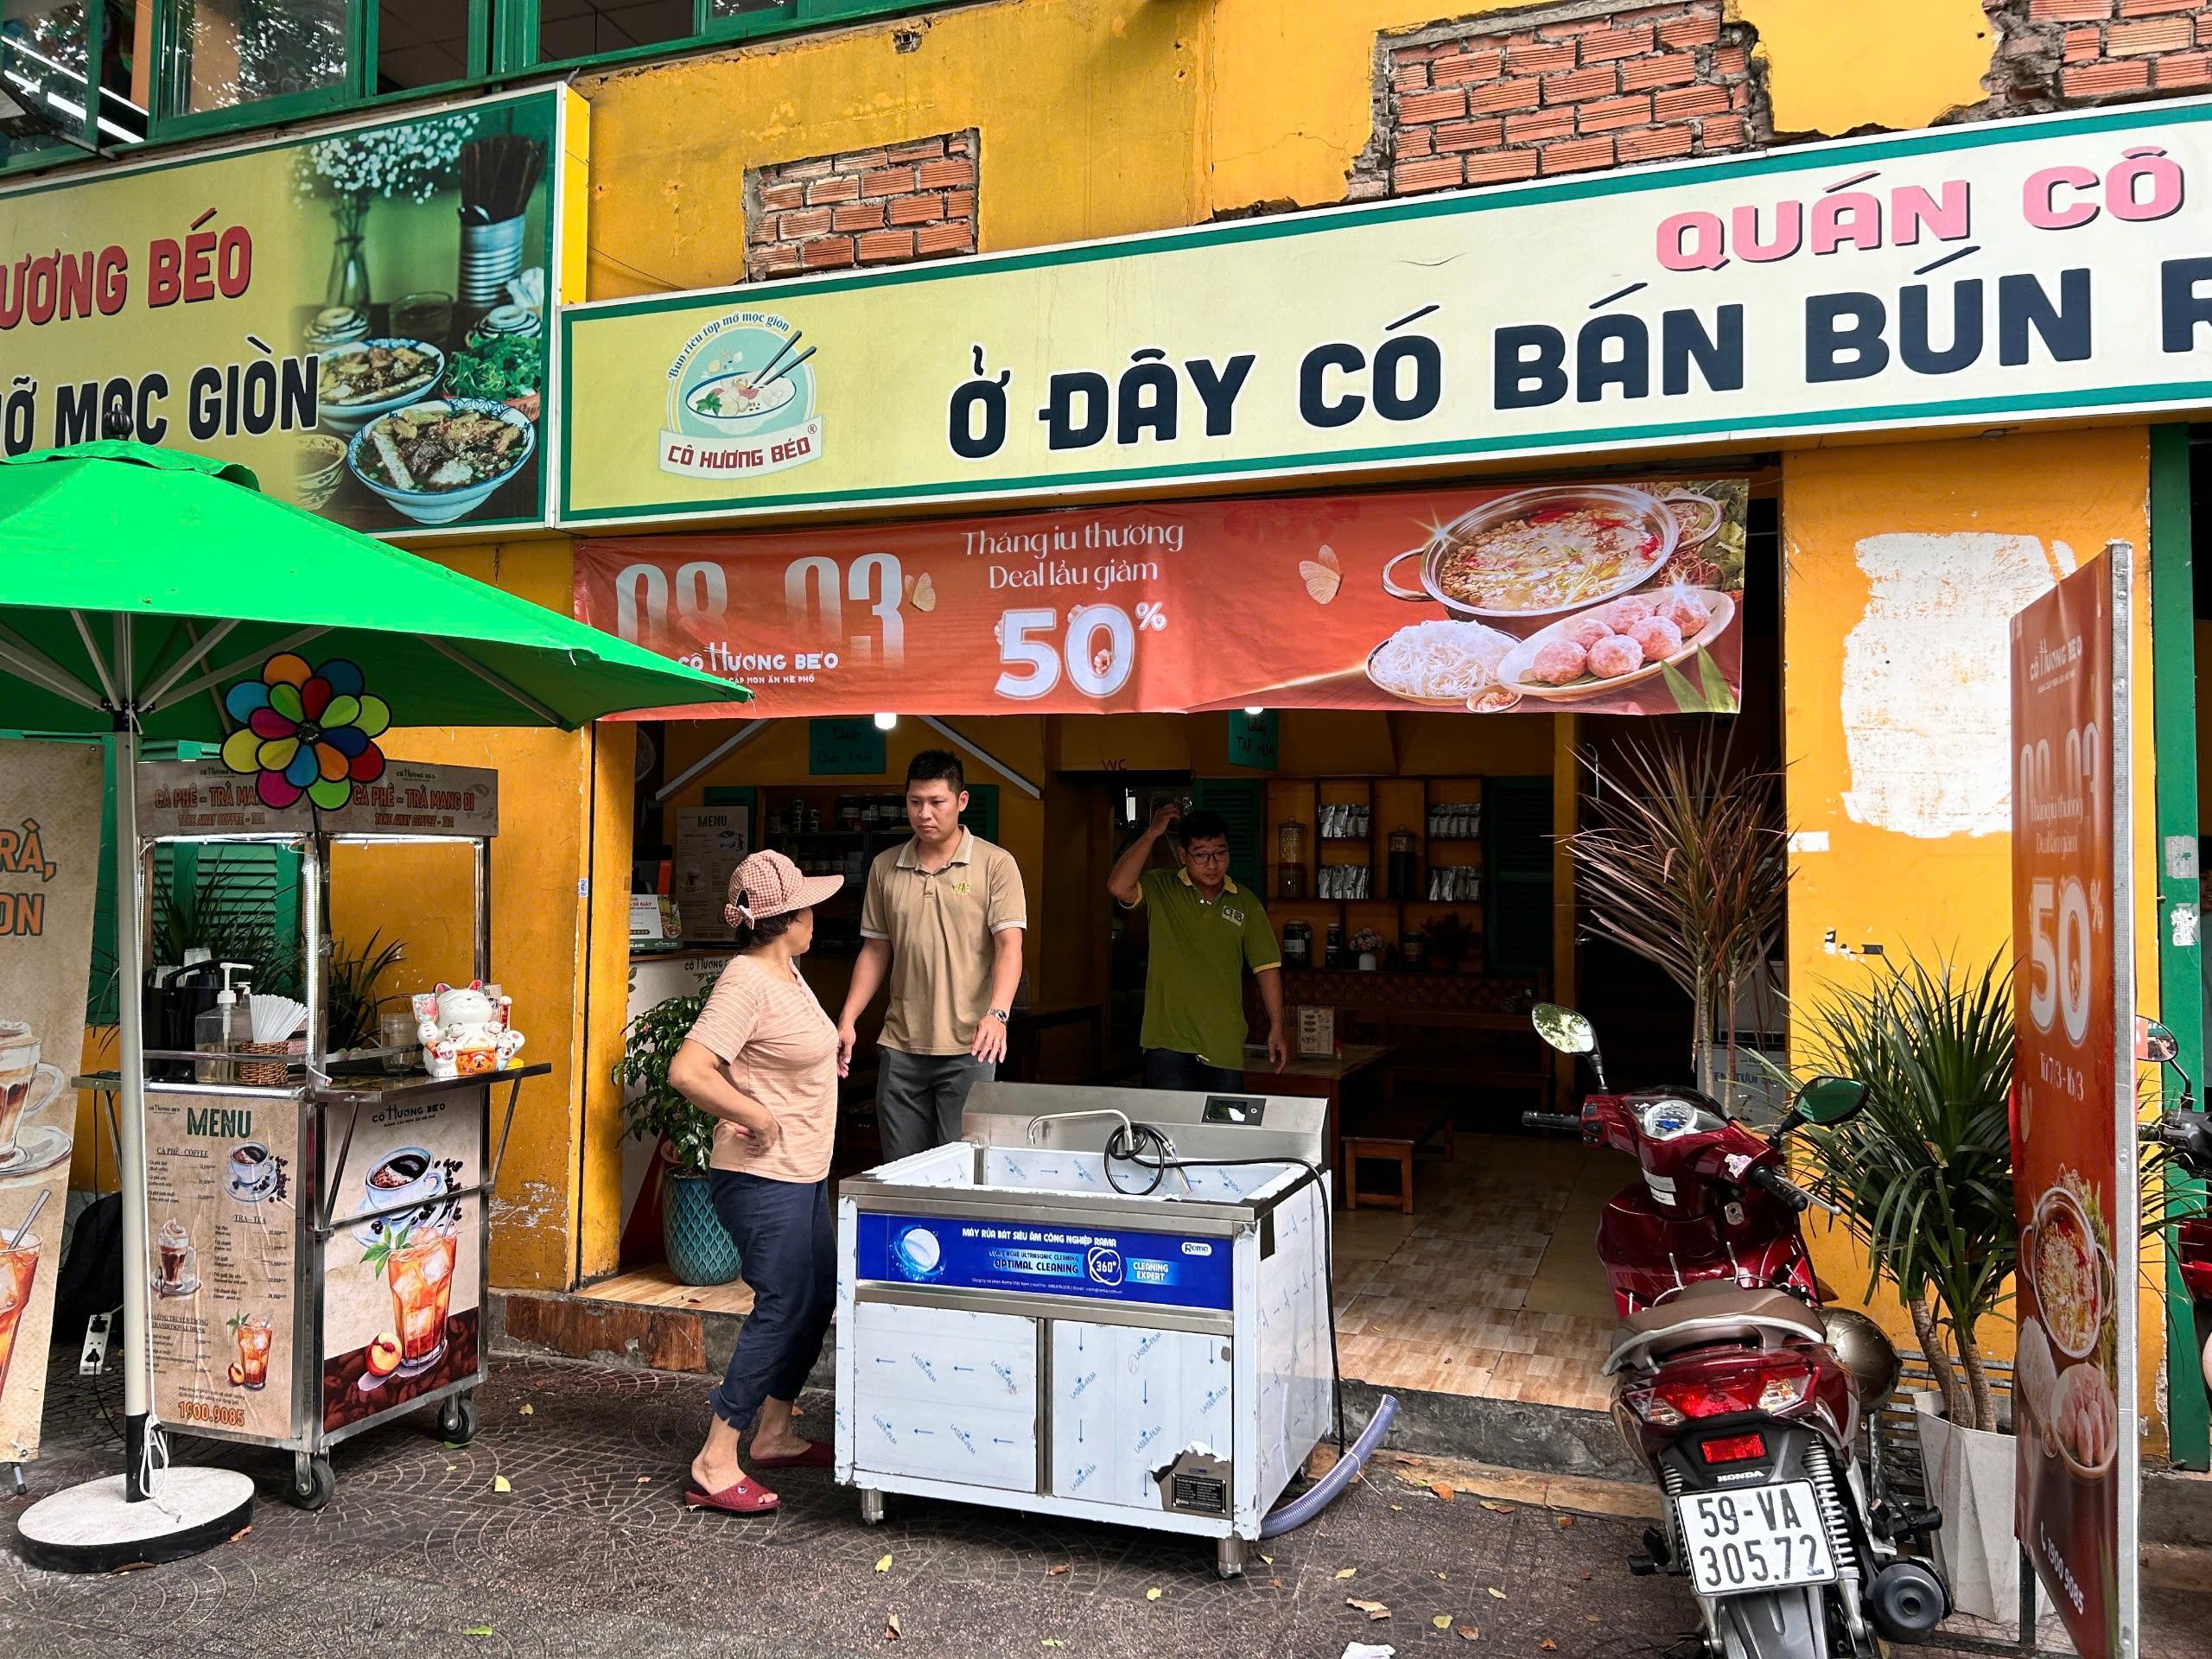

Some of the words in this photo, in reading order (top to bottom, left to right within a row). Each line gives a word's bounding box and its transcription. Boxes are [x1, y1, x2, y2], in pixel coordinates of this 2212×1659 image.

[1656, 168, 1972, 272] QUÁN
[2023, 145, 2185, 232] CÔ
[147, 207, 252, 309] BÉO
[950, 346, 1011, 460] Ở
[1039, 348, 1255, 452] ĐÂY
[1300, 304, 1442, 430] CÓ
[1493, 282, 1745, 410] BÁN
[1805, 245, 2093, 385] BÚN
[189, 334, 319, 441] GIÒN
[668, 444, 694, 466] CÔ
[700, 448, 763, 469] HƯƠNG
[771, 438, 811, 463] BÉO
[961, 530, 1048, 559] Tháng
[1054, 525, 1077, 550] iu
[1084, 522, 1184, 552] thương
[989, 563, 1044, 588] Deal
[1049, 560, 1088, 585] lẩu
[1094, 558, 1158, 591] giảm
[1101, 758, 1127, 772] WC
[155, 784, 171, 808] CÀ
[174, 783, 198, 808] PHÊ
[209, 781, 233, 806] TRÀ
[353, 784, 369, 805] CÀ
[372, 782, 394, 807] PHÊ
[405, 785, 429, 809] TRÀ
[430, 790, 461, 810] MANG
[463, 792, 474, 810] ĐI
[217, 813, 245, 826] COFFEE
[412, 814, 436, 827] COFFEE
[697, 815, 728, 828] MENU
[187, 1107, 251, 1138] MENU
[184, 1148, 208, 1157] COFFEE
[962, 1227, 979, 1237] MÁY
[997, 1229, 1011, 1240] BÁT
[1013, 1229, 1028, 1241] SIÊU
[1029, 1230, 1041, 1242] ÂM
[1043, 1231, 1065, 1243] CÔNG
[1066, 1234, 1093, 1248] NGHIỆP
[1094, 1236, 1117, 1248] RAMA
[1185, 1243, 1209, 1253] Rama
[995, 1258, 1033, 1270] OPTIMAL
[1036, 1261, 1079, 1274] CLEANING
[1020, 1251, 1052, 1260] ULTRASONIC
[1133, 1261, 1169, 1273] CLEANING
[1136, 1272, 1166, 1281] EXPERT
[1135, 1332, 1162, 1360] LASER-FILM
[911, 1352, 937, 1382] LASER-FILM
[1071, 1371, 1097, 1400] LASER-FILM
[1200, 1385, 1230, 1414] LASER-FILM
[178, 1401, 245, 1427] 1900.9085
[872, 1414, 897, 1446] LASER-FILM
[950, 1424, 976, 1455] LASER-FILM
[1134, 1426, 1162, 1453] LASER-FILM
[1070, 1465, 1097, 1492] LASER-FILM
[1716, 1470, 1764, 1483] HONDA
[1696, 1488, 1802, 1538] 59-VA
[1699, 1534, 1825, 1587] 305.72
[2048, 1537, 2064, 1580] 1900
[2063, 1567, 2084, 1616] 9085
